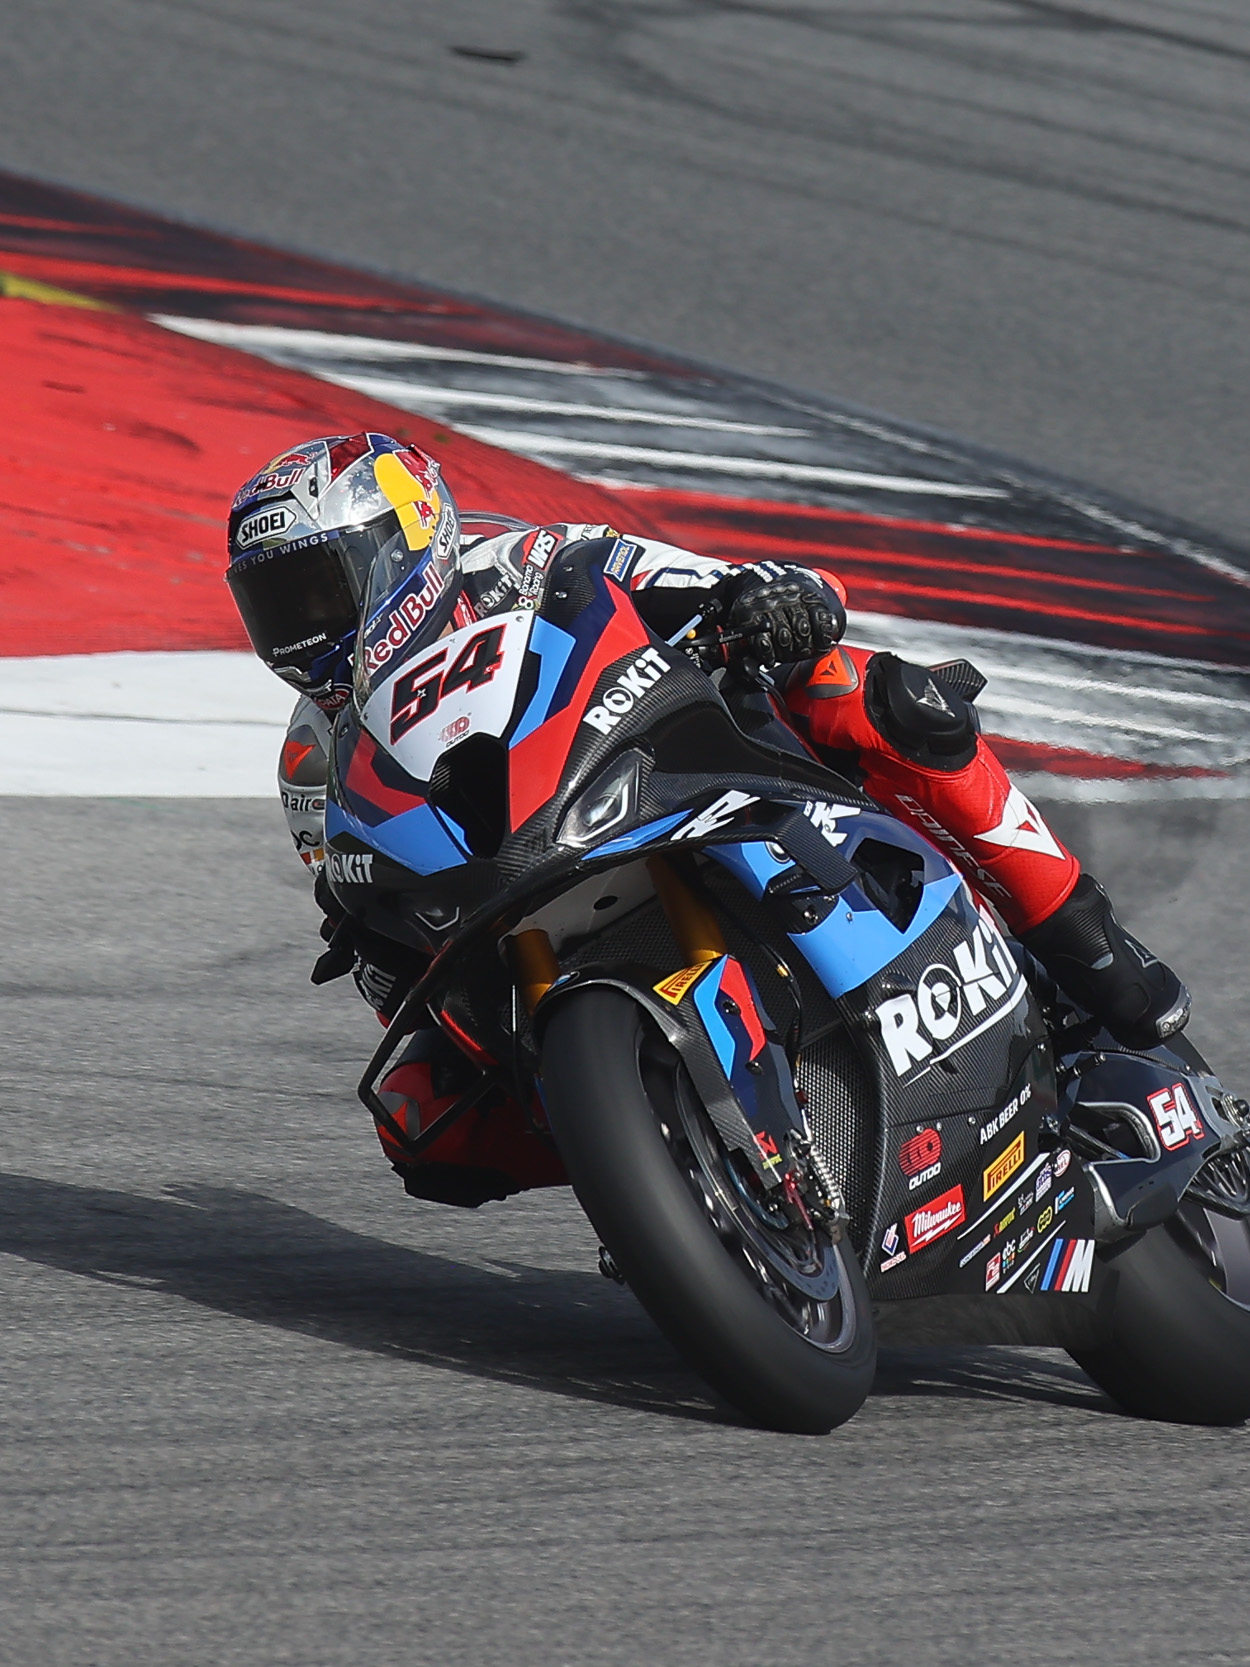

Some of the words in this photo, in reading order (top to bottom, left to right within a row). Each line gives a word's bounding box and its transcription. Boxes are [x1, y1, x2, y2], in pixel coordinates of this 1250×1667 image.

[265, 468, 306, 491] Bull
[241, 511, 285, 543] SHOEI
[250, 550, 274, 566] YOU
[280, 533, 328, 555] WINGS
[527, 529, 556, 569] WRS
[348, 610, 412, 677] Red
[400, 561, 445, 632] Bull
[389, 622, 508, 746] 54
[979, 1120, 1000, 1145] ABK
[998, 1097, 1019, 1129] BEER
[1019, 1083, 1032, 1106] 0%
[1147, 1082, 1204, 1151] 54
[909, 1161, 942, 1190] OUTDO
[987, 1137, 1022, 1194] PIRELLI
[912, 1201, 962, 1238] Milwaukee
[1061, 1239, 1096, 1293] M
